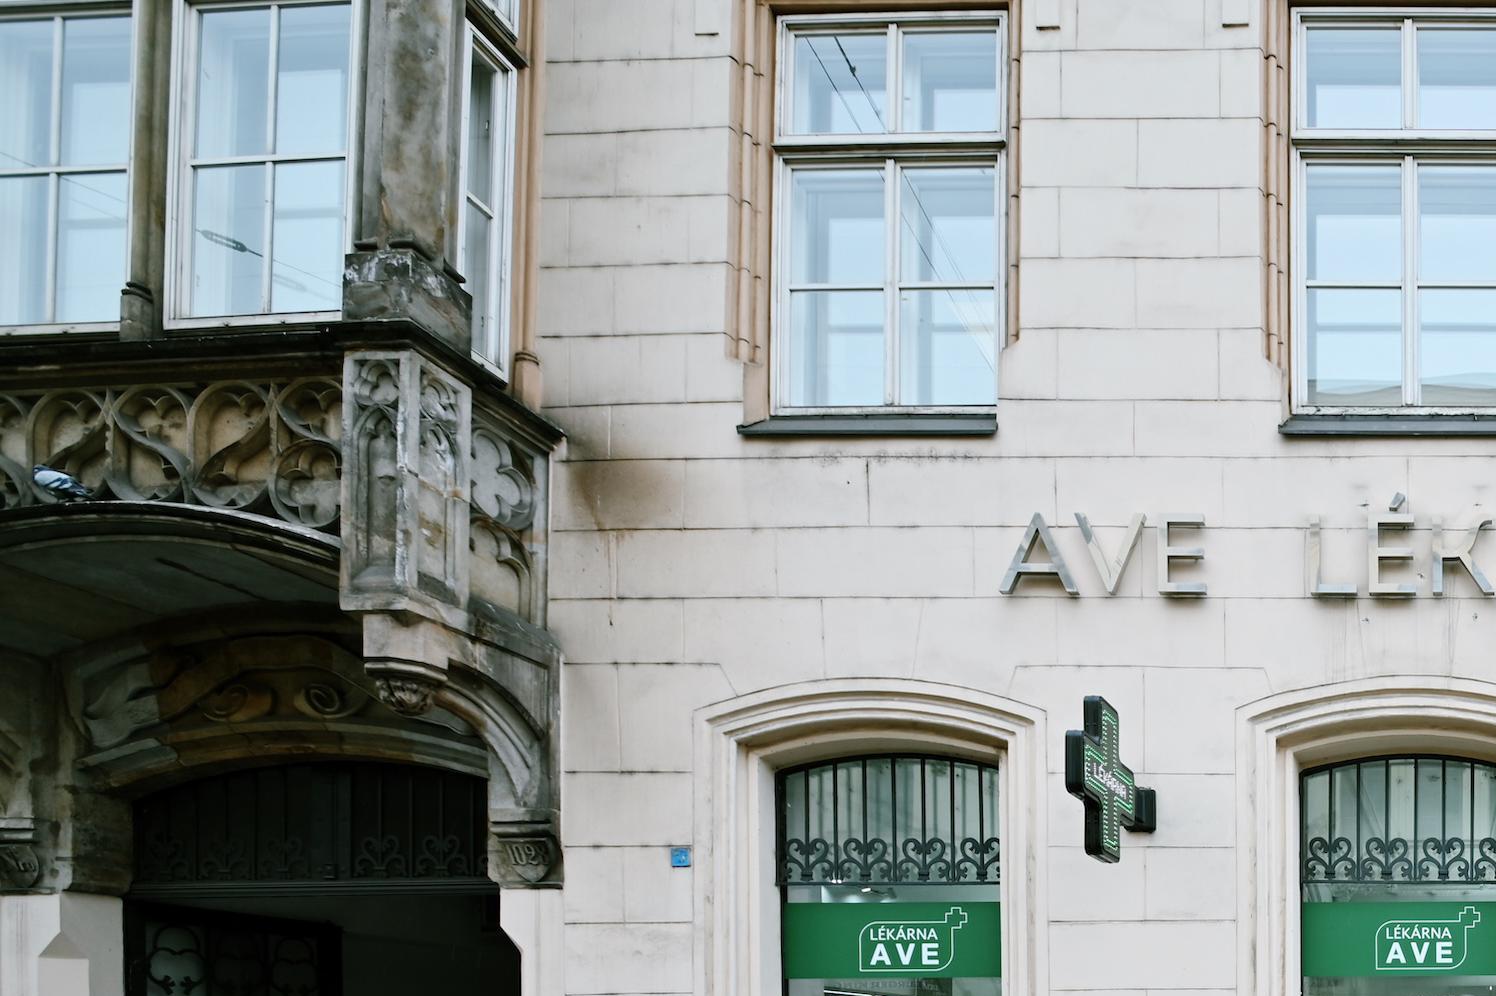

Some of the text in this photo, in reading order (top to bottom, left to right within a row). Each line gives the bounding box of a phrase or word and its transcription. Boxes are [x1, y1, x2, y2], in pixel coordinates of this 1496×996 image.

[999, 512, 1208, 596] AVE
[869, 925, 938, 941] LÉKÁRNA
[1385, 923, 1452, 940] LÉKÁRNA
[869, 943, 940, 966] AVE
[1385, 941, 1454, 964] AVE
